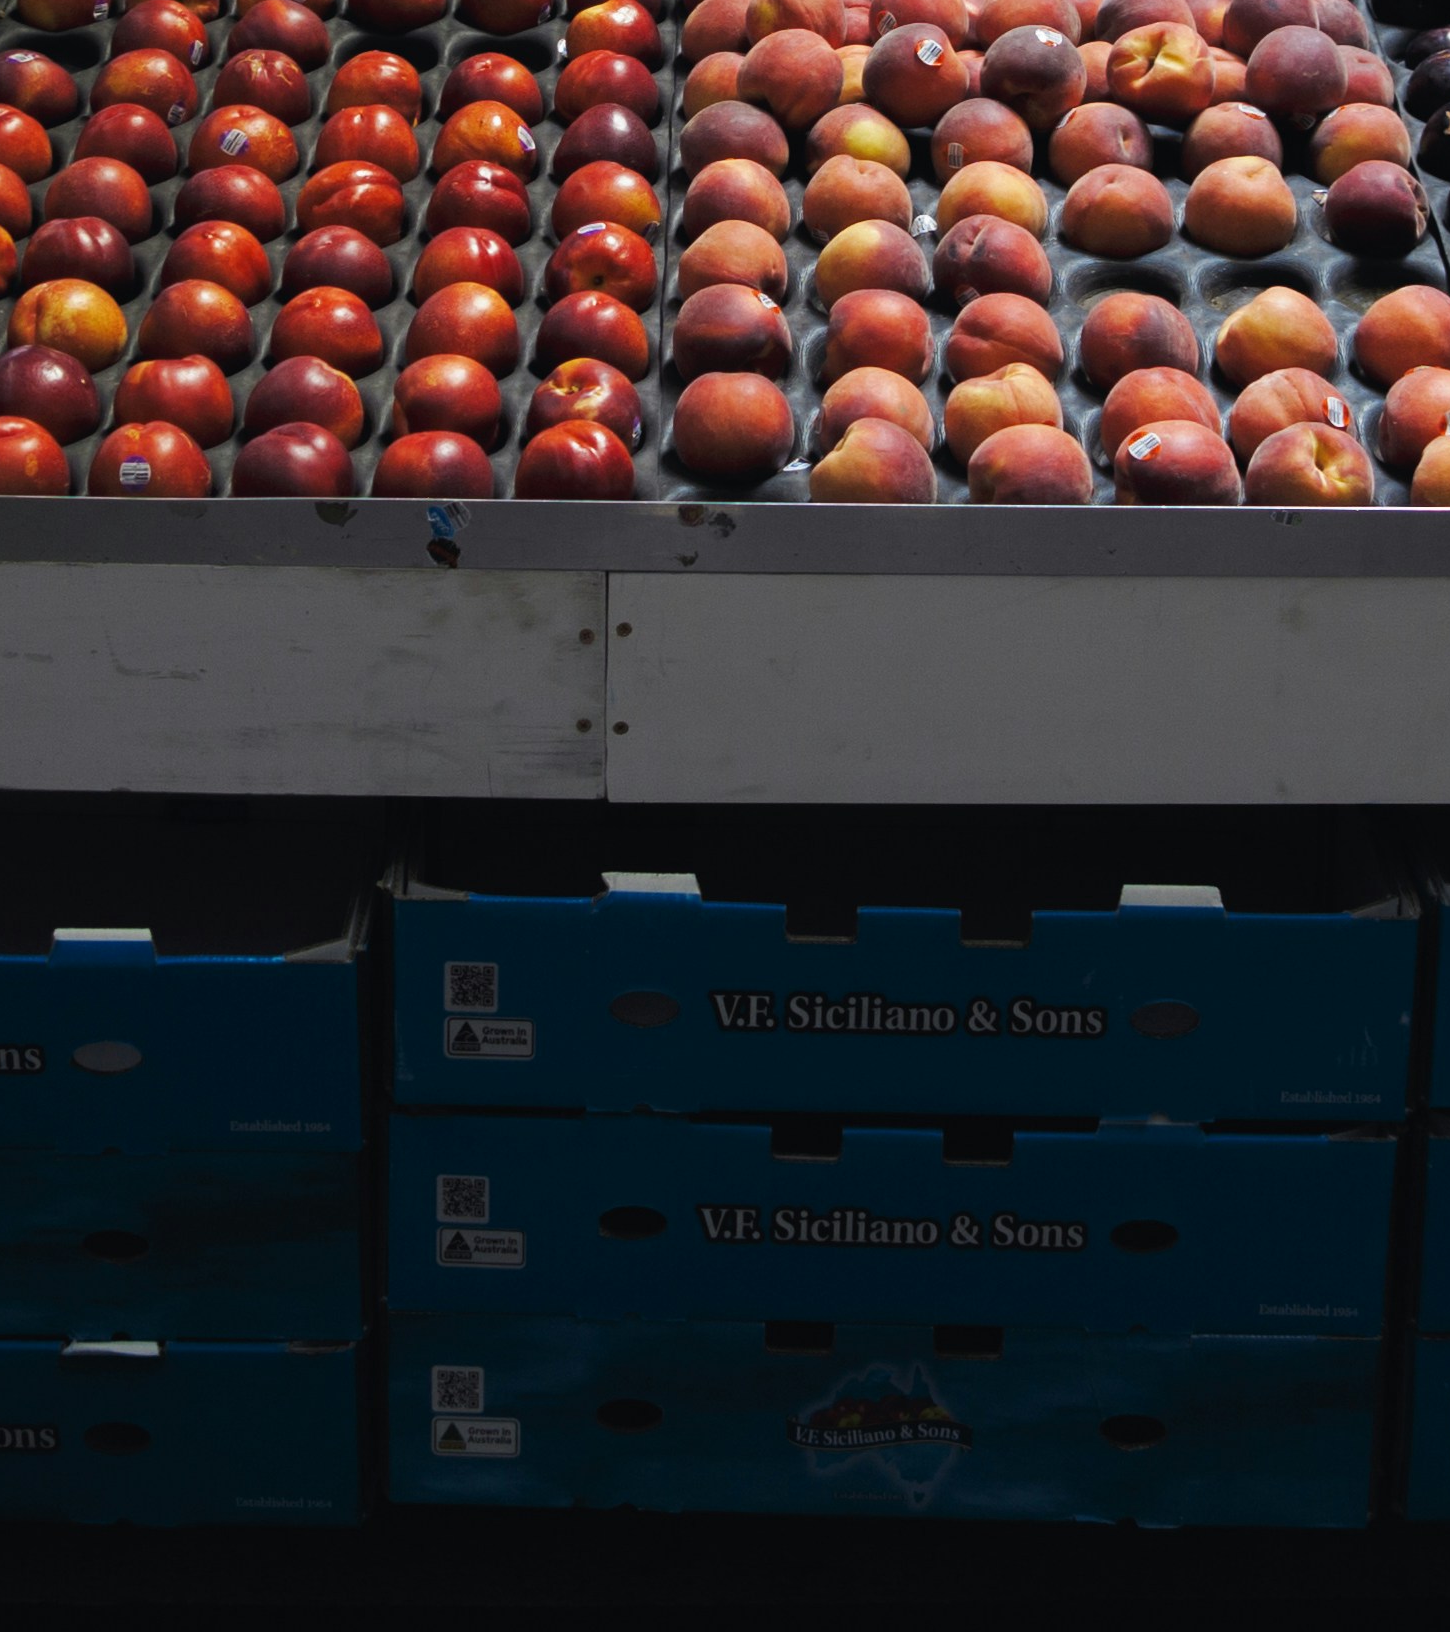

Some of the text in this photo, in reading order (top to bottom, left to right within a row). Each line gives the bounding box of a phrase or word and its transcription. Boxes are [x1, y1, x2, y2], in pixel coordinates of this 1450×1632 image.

[713, 994, 1103, 1034] V.F. Siciliano & Sons
[482, 1026, 527, 1036] Grown in
[481, 1035, 527, 1046] Australia
[1280, 1090, 1352, 1104] Established
[229, 1119, 302, 1133] Established
[700, 1208, 1084, 1248] V.F. Siciliano & Sons
[473, 1236, 517, 1246] Grown in
[473, 1244, 518, 1255] Australia
[1258, 1303, 1330, 1317] Established
[468, 1426, 511, 1436] Grown in
[822, 1427, 896, 1447] Siciliano
[899, 1423, 914, 1440] &
[917, 1422, 961, 1441] Sons
[467, 1434, 512, 1445] Australia
[235, 1496, 304, 1509] Established
